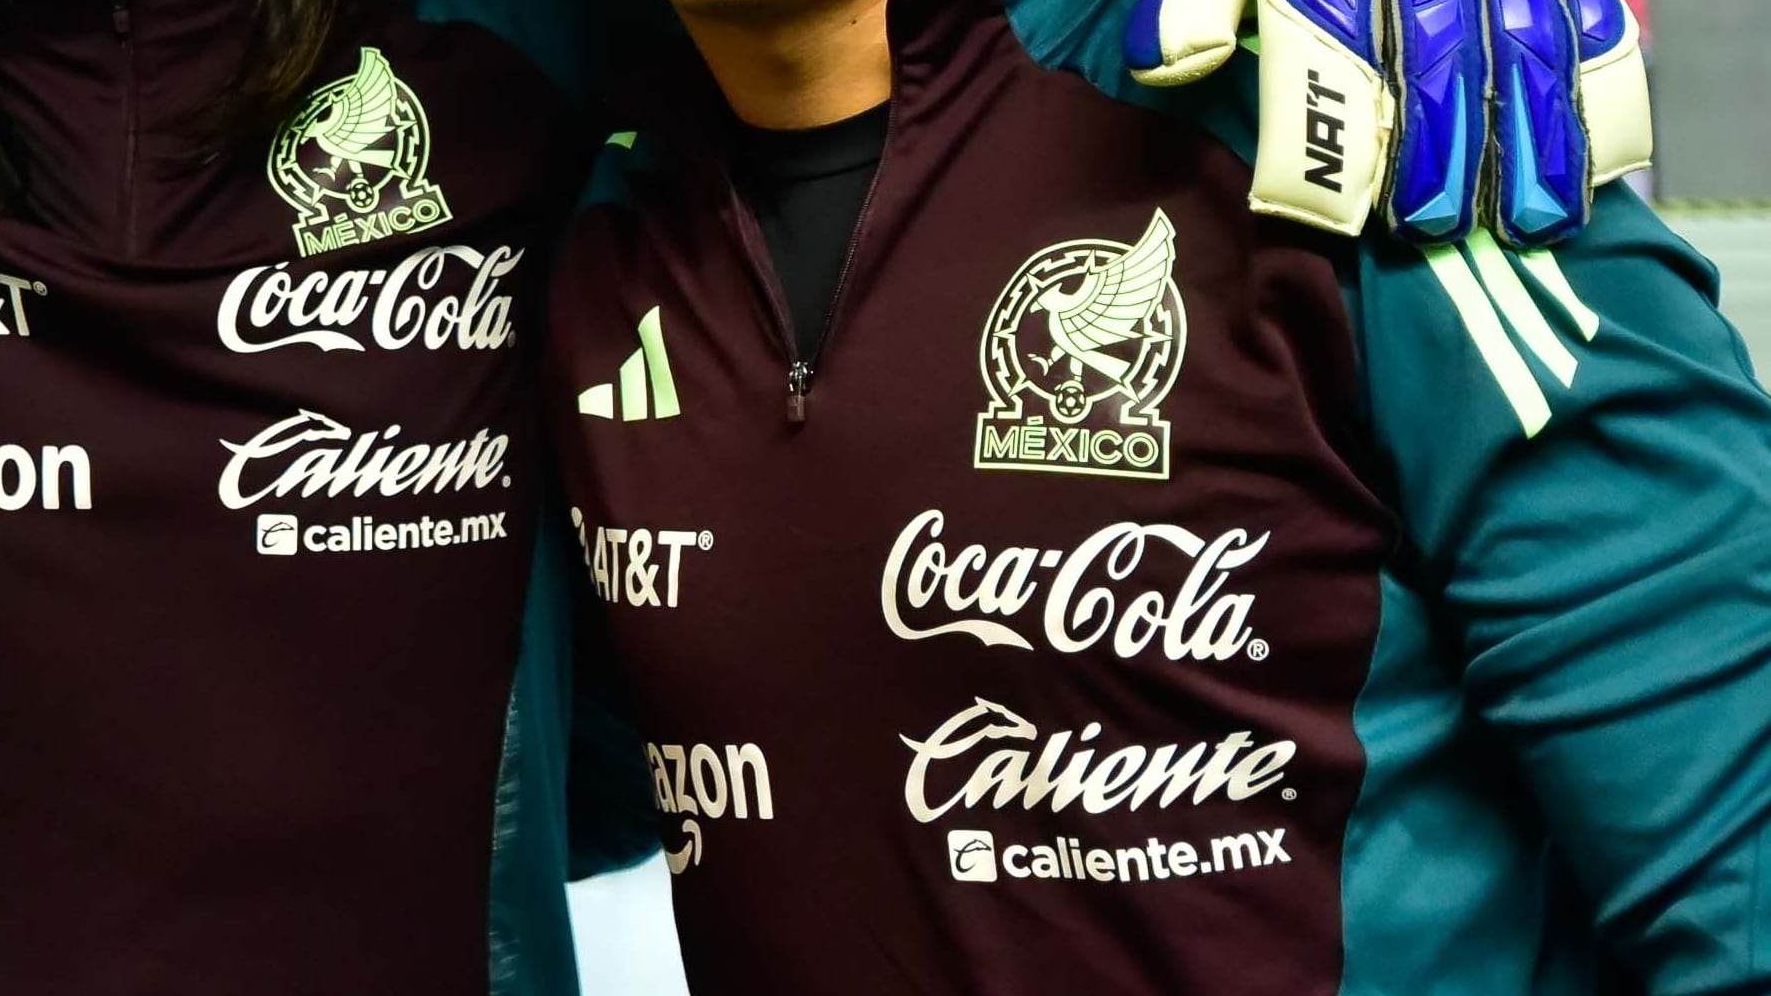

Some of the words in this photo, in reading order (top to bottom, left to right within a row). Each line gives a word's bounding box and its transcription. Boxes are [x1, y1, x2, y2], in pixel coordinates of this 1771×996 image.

[303, 199, 440, 256] MÉXICO
[218, 245, 525, 354] Coca-Cola
[983, 416, 1159, 467] MÉXICO
[303, 512, 508, 554] caliente.mx
[881, 509, 1270, 661] Coca-Cola
[1002, 828, 1292, 883] caliente.mx
